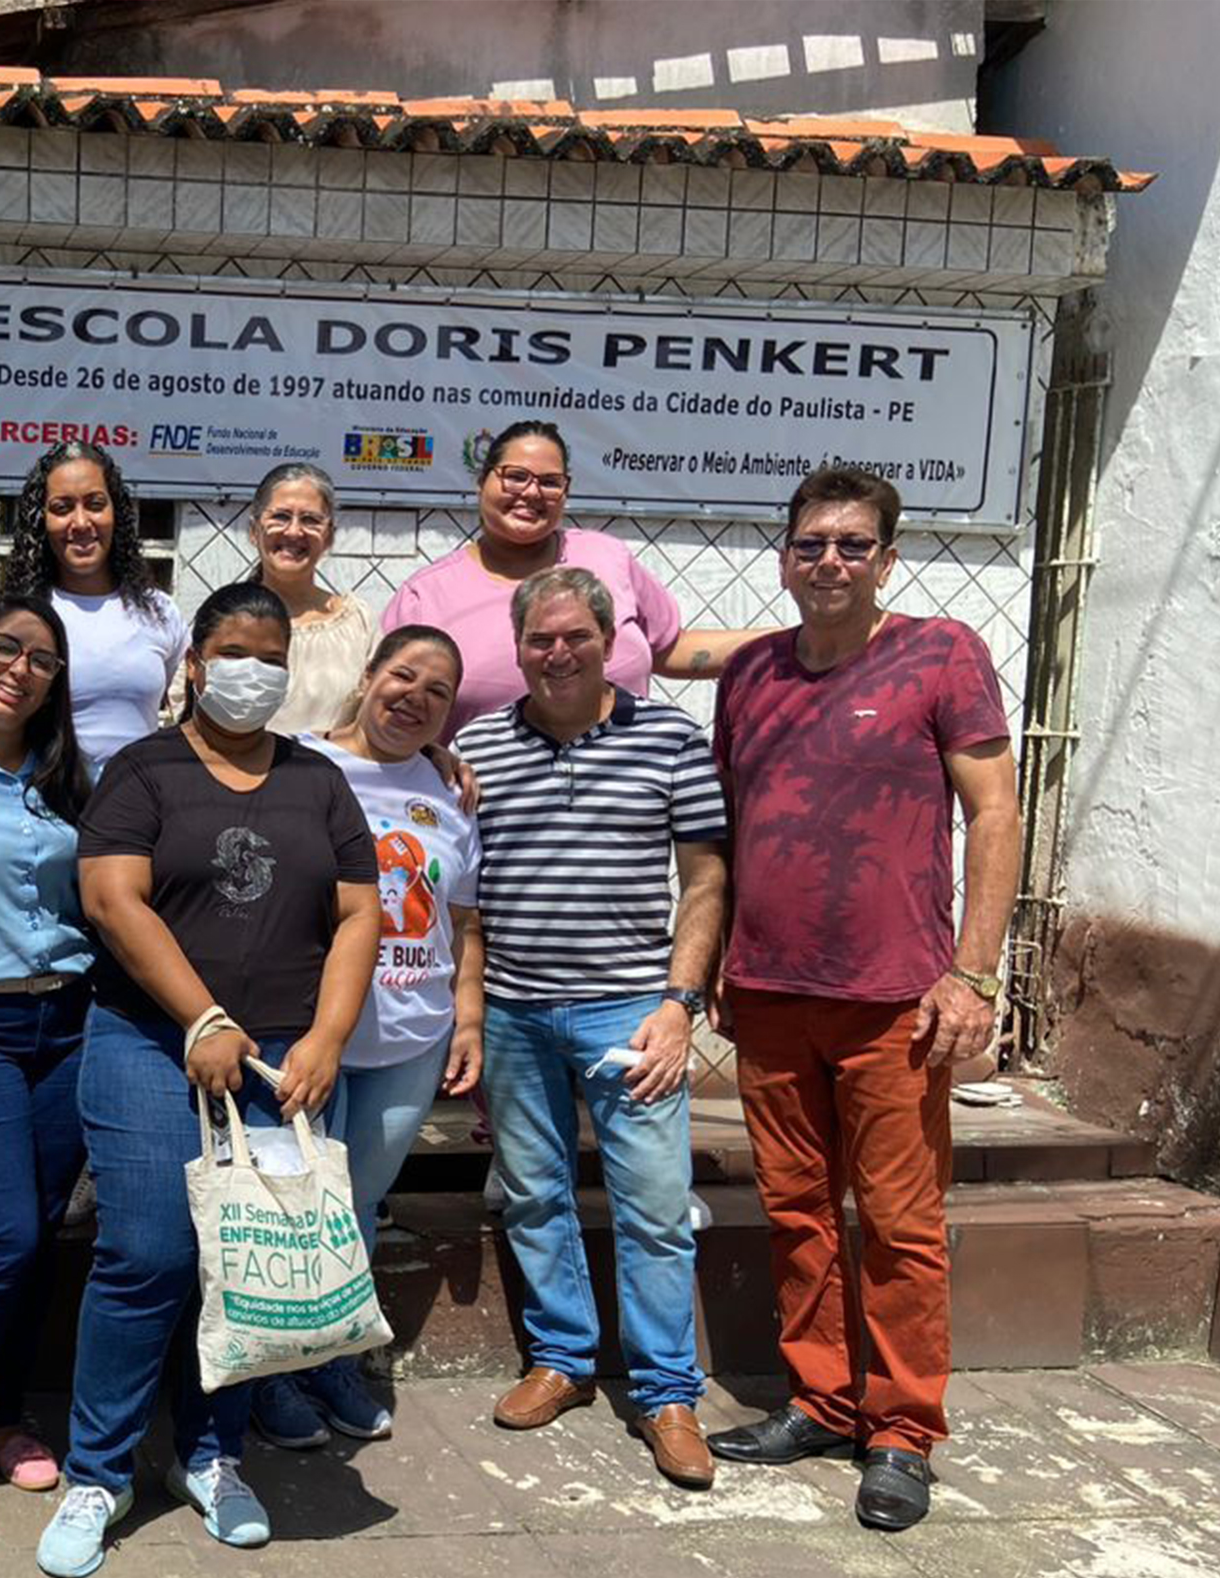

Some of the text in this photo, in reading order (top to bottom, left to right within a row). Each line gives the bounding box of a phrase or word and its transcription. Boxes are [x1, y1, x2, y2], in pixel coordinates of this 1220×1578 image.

[316, 320, 571, 366] DORIS
[603, 333, 950, 381] PENKERT
[77, 367, 105, 390] 26
[113, 368, 140, 391] de
[148, 373, 225, 400] agosto
[233, 373, 261, 396] de
[269, 375, 325, 399] 1997
[333, 378, 425, 403] atuando
[432, 386, 472, 405] nas
[478, 386, 626, 412] comunidades
[632, 391, 658, 413] da
[666, 391, 740, 416] Cidade
[746, 394, 772, 417] do
[780, 396, 865, 421] Paulista
[888, 401, 915, 423] PE
[150, 424, 202, 451] FNDE
[207, 426, 231, 439] Fundo
[232, 427, 267, 440] Nacional
[688, 455, 698, 473] o
[702, 450, 737, 475] Meio
[832, 455, 903, 480] Preservar
[906, 461, 915, 480] a
[919, 458, 966, 482] VIDA»
[220, 1203, 241, 1221] XII
